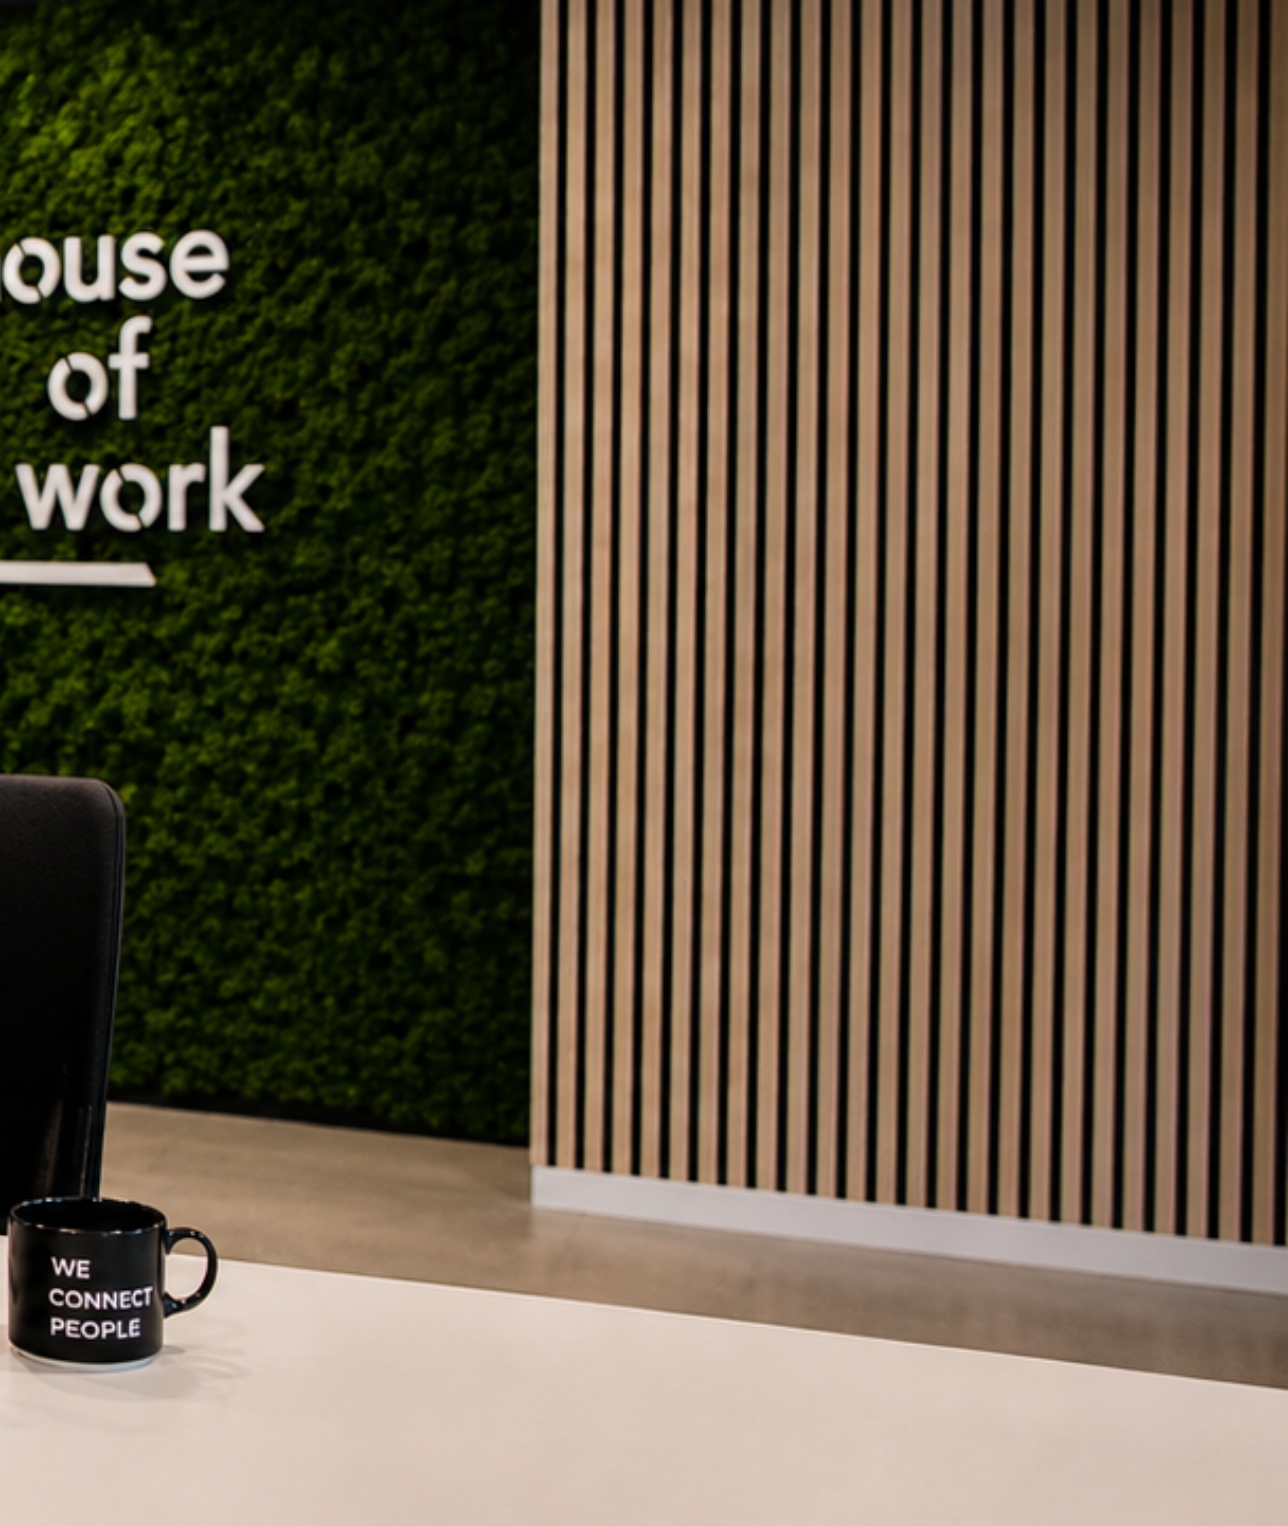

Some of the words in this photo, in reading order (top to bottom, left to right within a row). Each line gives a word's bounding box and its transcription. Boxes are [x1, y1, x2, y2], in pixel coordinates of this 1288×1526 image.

[47, 315, 153, 421] of
[15, 425, 265, 532] work
[51, 1256, 91, 1279] WE
[49, 1286, 154, 1310] CONNECT
[50, 1317, 141, 1339] PEOPLE
